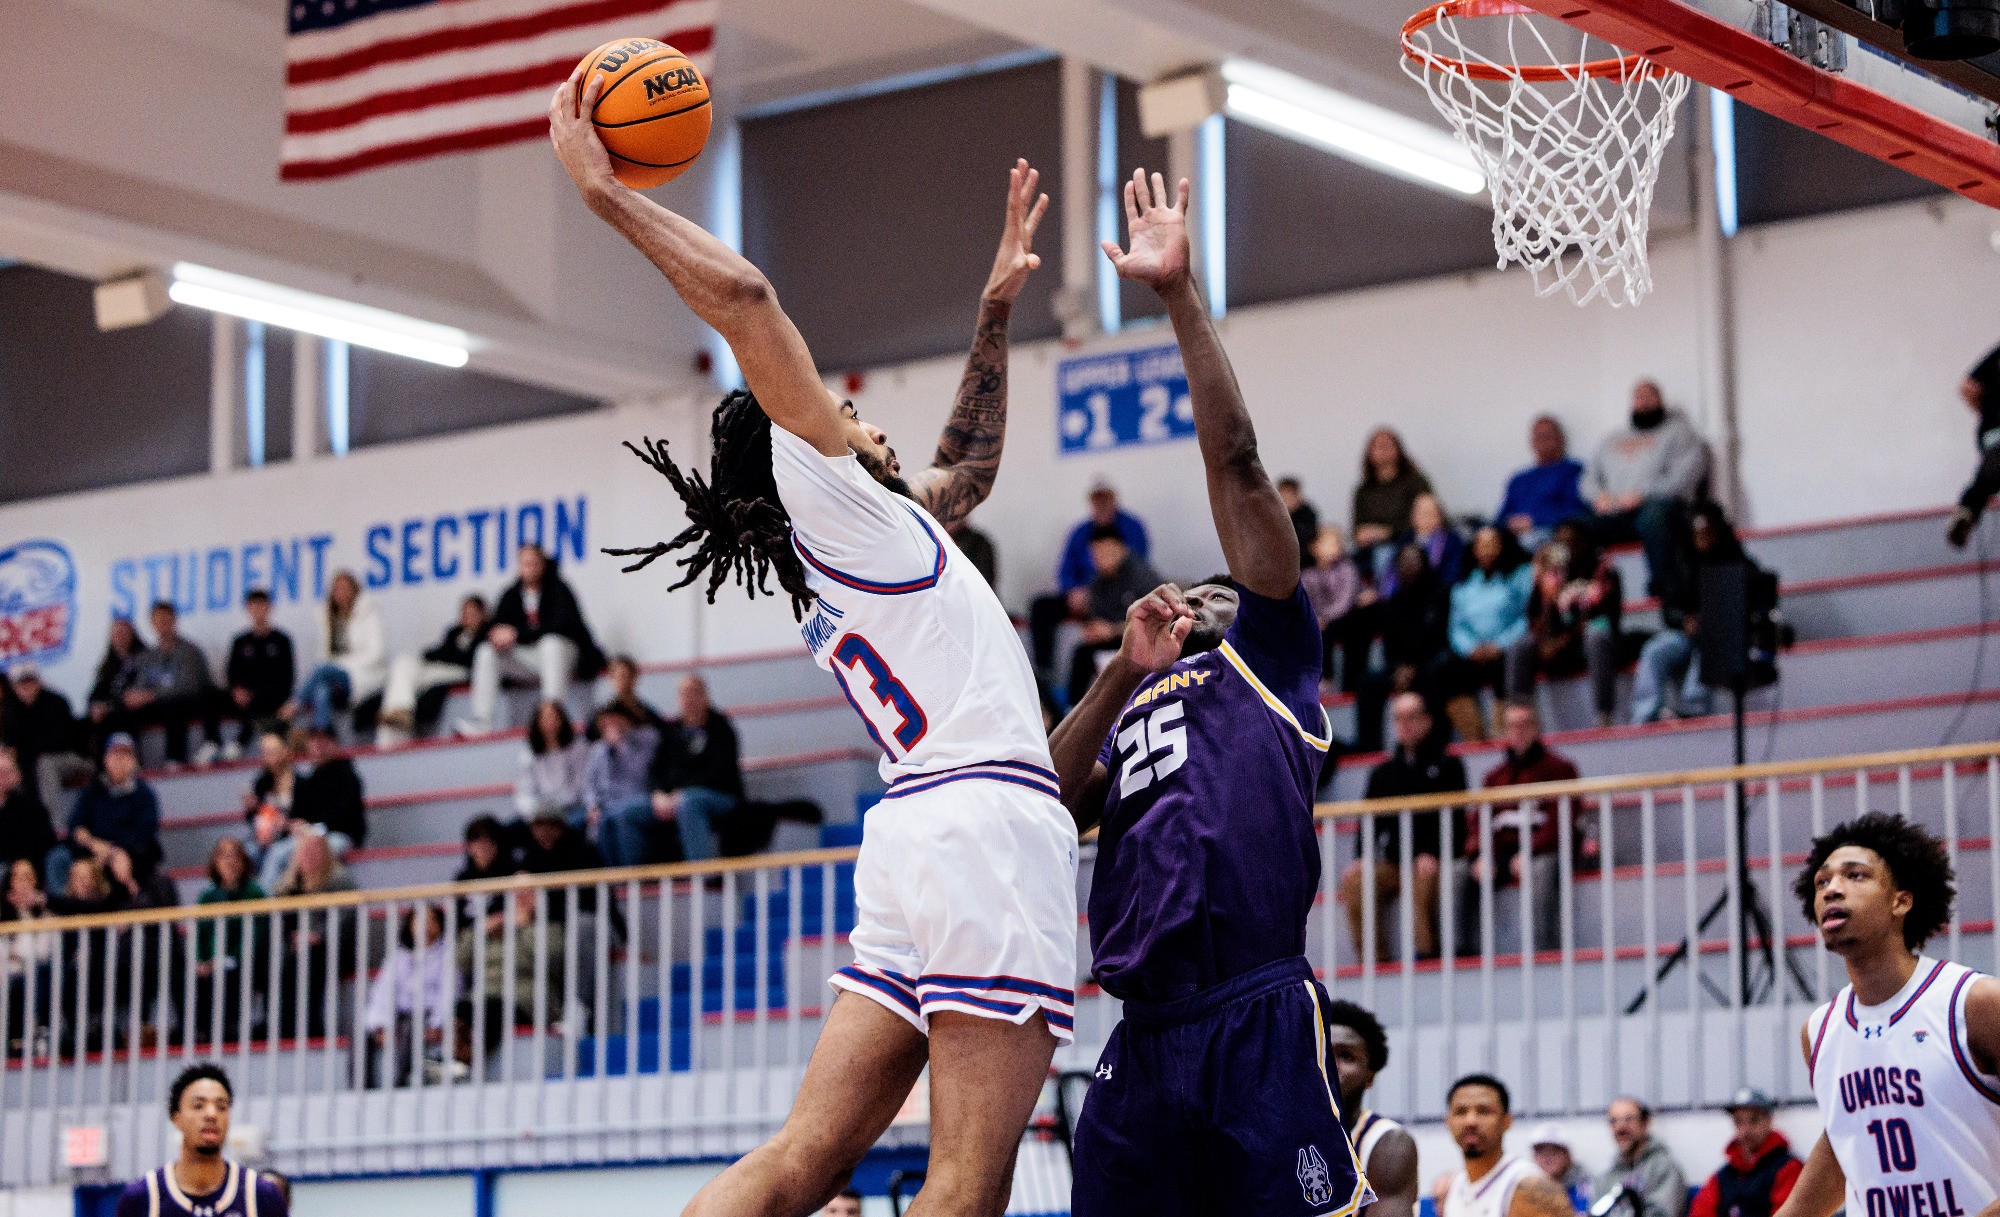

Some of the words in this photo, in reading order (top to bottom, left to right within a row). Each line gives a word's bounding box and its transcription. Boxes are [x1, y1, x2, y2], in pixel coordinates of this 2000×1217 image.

[643, 67, 701, 101] NCAA
[1087, 393, 1116, 446] 1
[1139, 387, 1171, 440] 2
[109, 534, 334, 620] STUDENT
[362, 495, 588, 590] SECTION
[829, 633, 928, 763] 13
[1117, 700, 1188, 799] 25
[1839, 1066, 1924, 1113] UMASS
[1867, 1117, 1917, 1173] 10
[1857, 1178, 1964, 1217] OWELL
